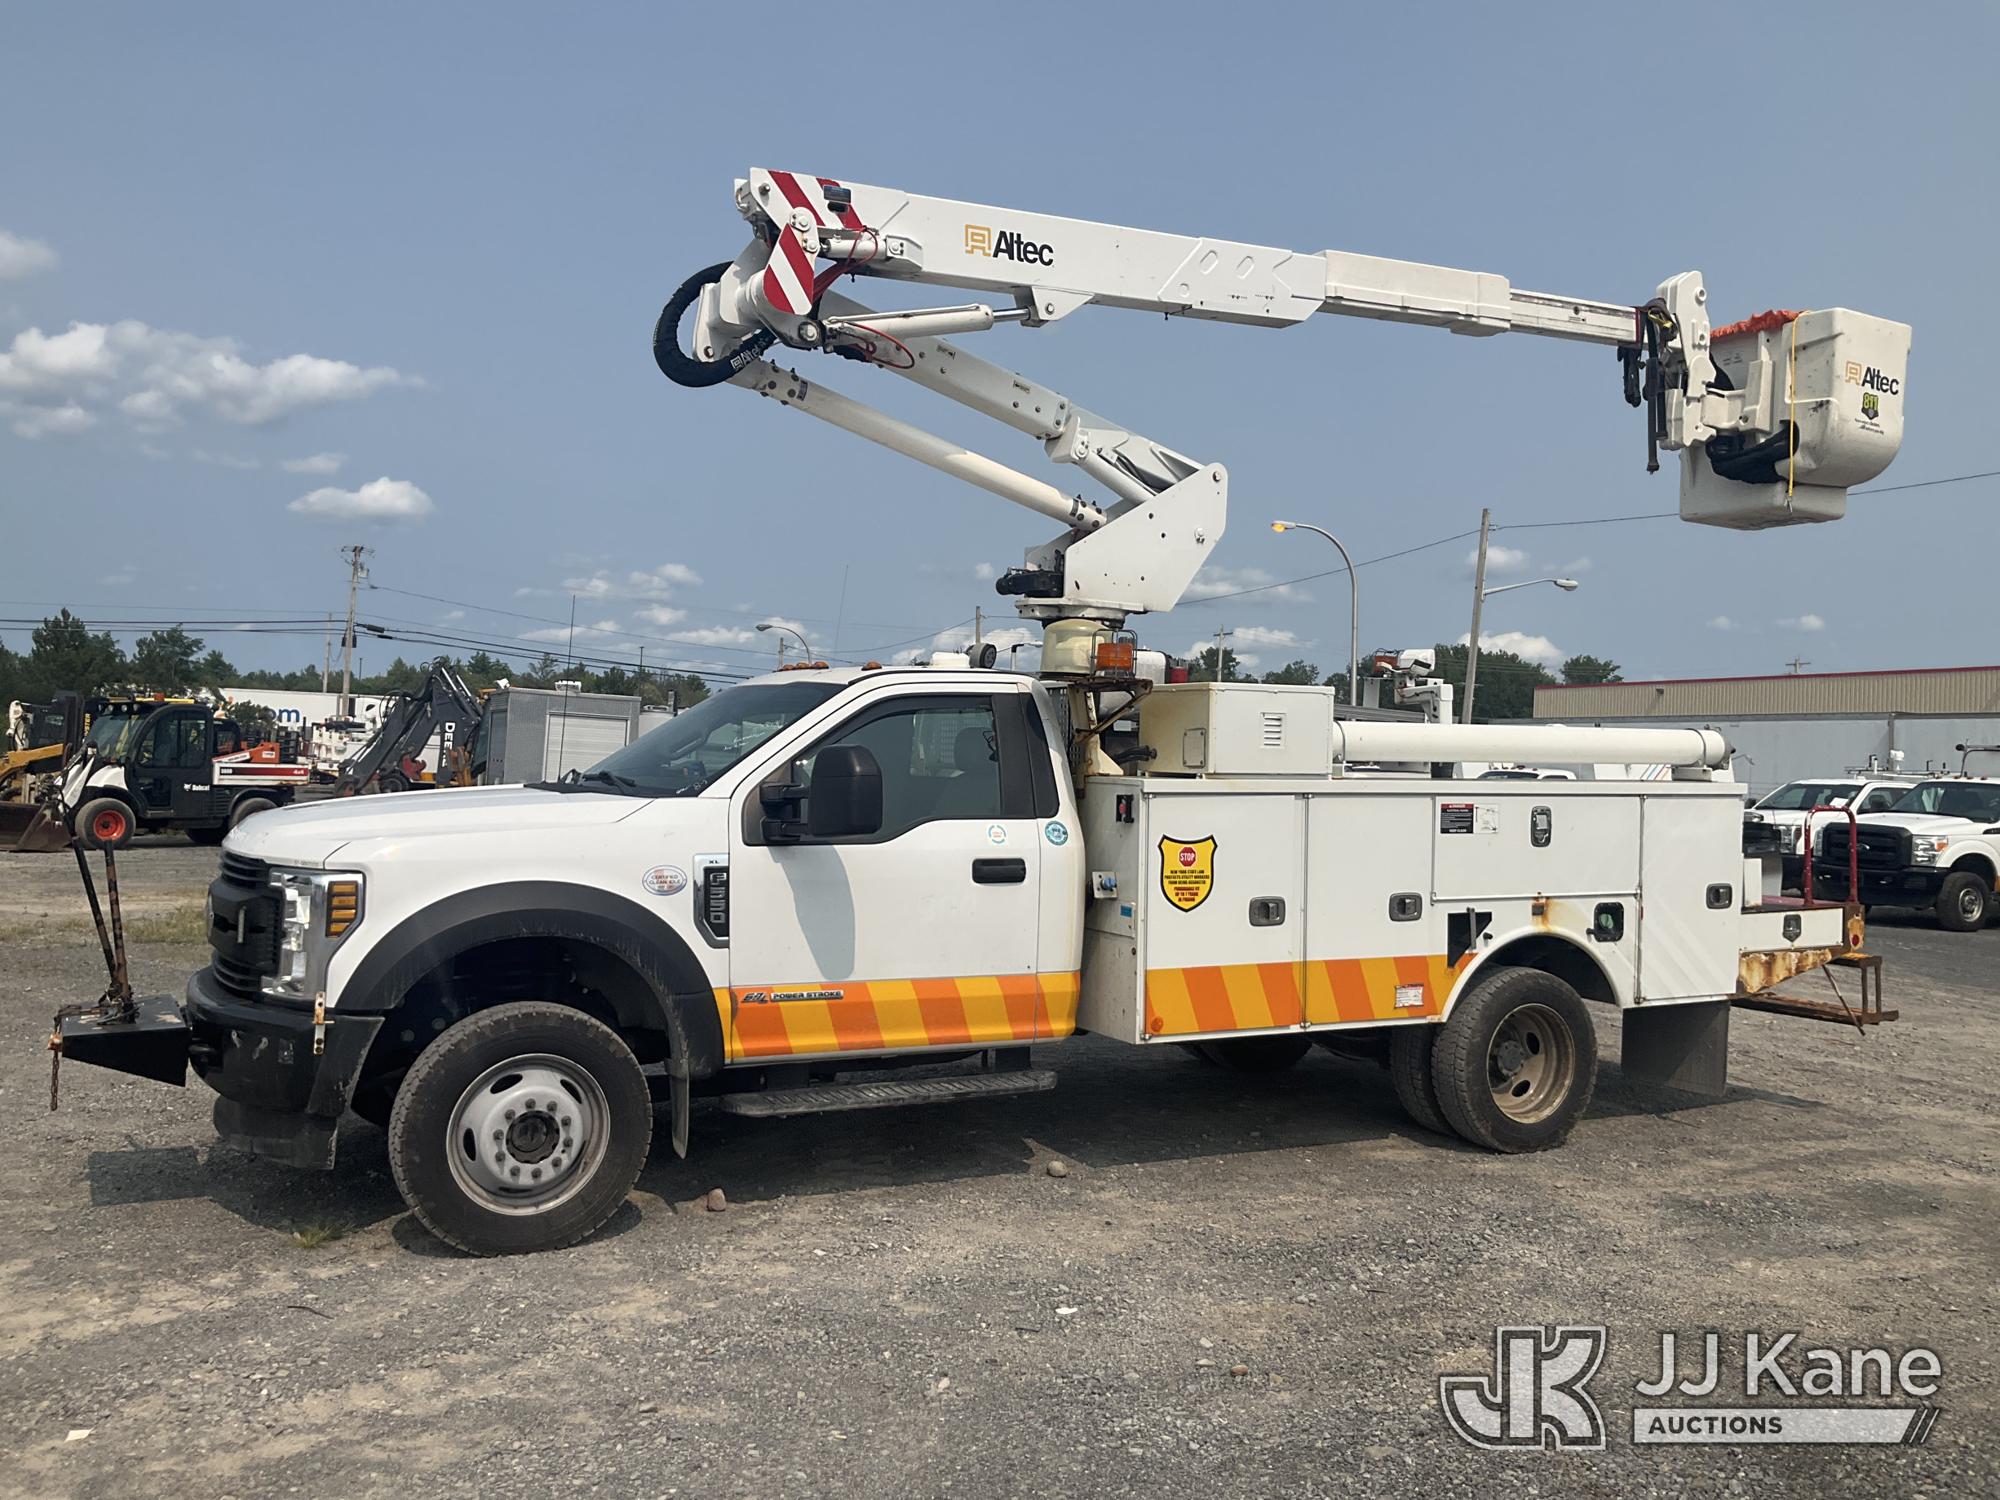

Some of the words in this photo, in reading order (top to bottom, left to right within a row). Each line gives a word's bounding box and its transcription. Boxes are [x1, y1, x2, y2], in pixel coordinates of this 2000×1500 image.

[992, 230, 1054, 267] Altec
[1861, 366, 1900, 396] Altec
[1863, 392, 1879, 411] 811
[1180, 852, 1195, 861] STOP
[773, 992, 804, 1000] POWER
